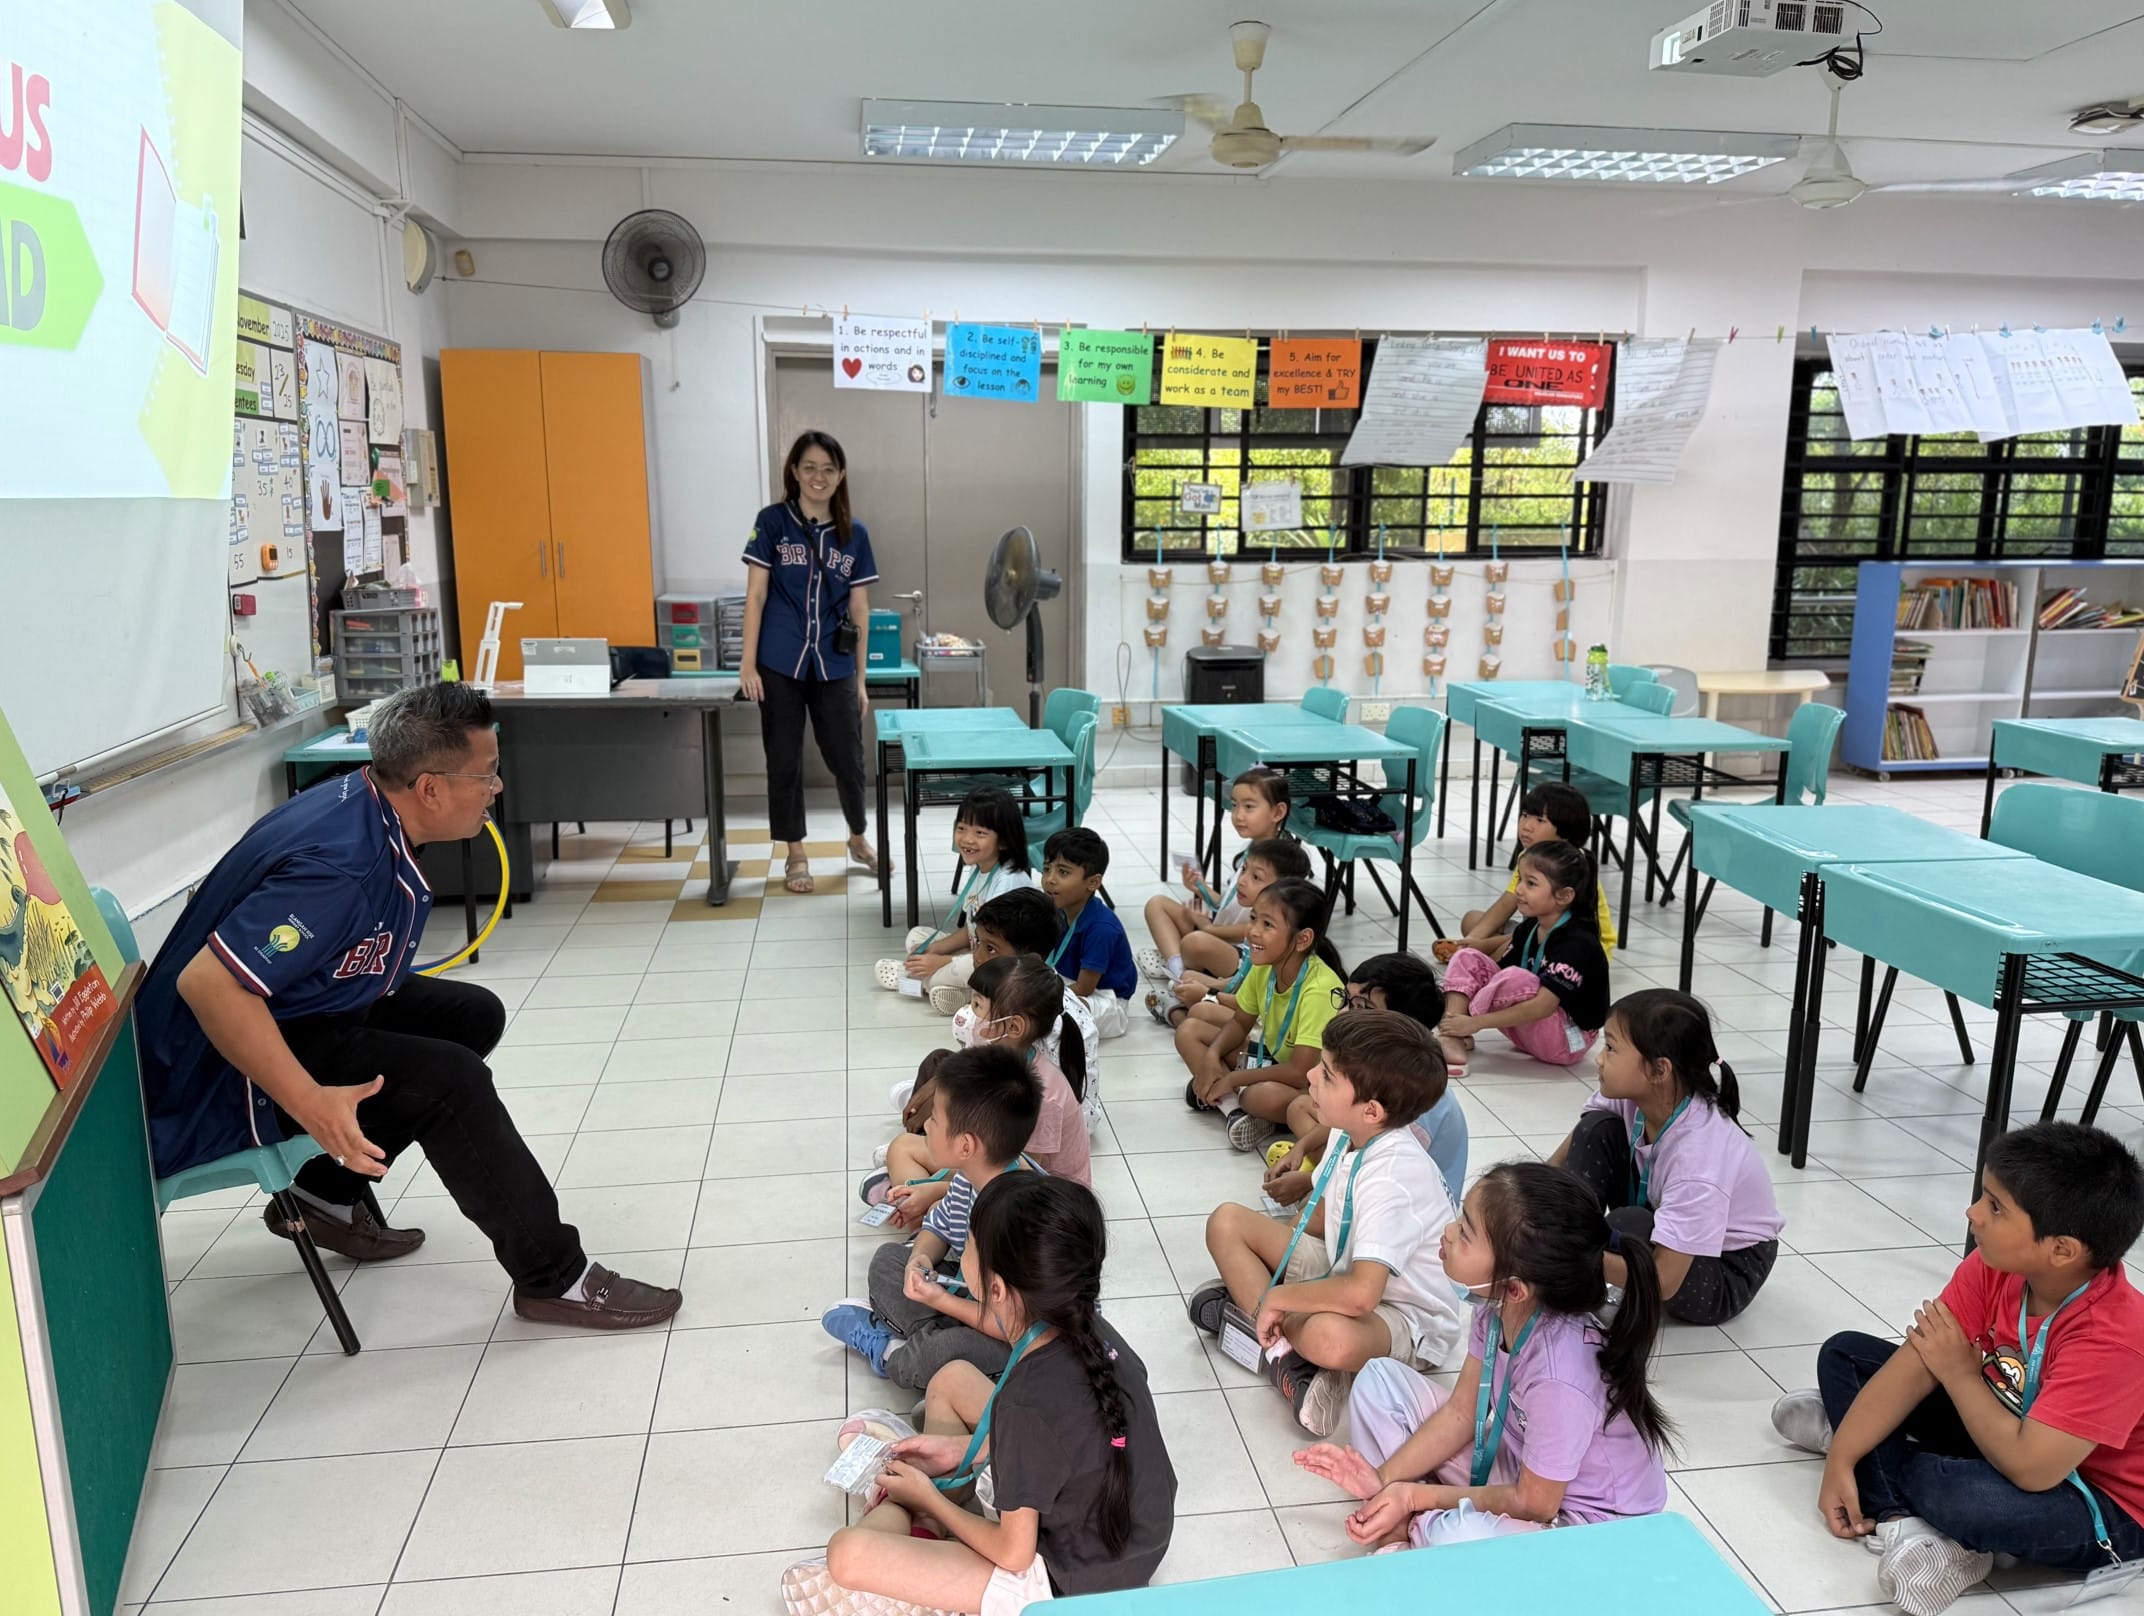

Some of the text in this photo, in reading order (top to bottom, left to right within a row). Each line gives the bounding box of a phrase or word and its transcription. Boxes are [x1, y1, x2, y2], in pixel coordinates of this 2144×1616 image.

[0, 219, 46, 331] D
[838, 326, 927, 340] 1. Be respectful
[967, 332, 1020, 345] 2. Be self-
[841, 344, 925, 356] in actions and in
[960, 348, 1027, 363] disciplined and
[1064, 341, 1149, 356] 3. Be responsible
[1196, 349, 1225, 359] 4. Be
[1499, 346, 1586, 362] I WANT US TO
[1289, 353, 1341, 363] 5. Aim for
[236, 361, 256, 382] esday
[868, 361, 898, 371] words
[963, 364, 1021, 377] focus on the
[1078, 359, 1134, 373] for my own
[1167, 365, 1251, 379] considerate and
[1273, 368, 1356, 379] excellence & TRY
[1490, 364, 1583, 384] BE UNITED AS
[977, 381, 1006, 392] lesson
[1069, 375, 1107, 388] learning
[1503, 378, 1564, 392] ONE
[1165, 384, 1190, 394] work
[1195, 386, 1206, 395] as
[1221, 387, 1250, 398] team
[1277, 384, 1323, 396] my BEST!
[235, 396, 257, 411] entees
[257, 480, 268, 496] 35
[777, 543, 855, 577] BR PS
[332, 931, 392, 980] BR
[77, 979, 101, 1003] Eggleton
[89, 993, 107, 1008] Webb
